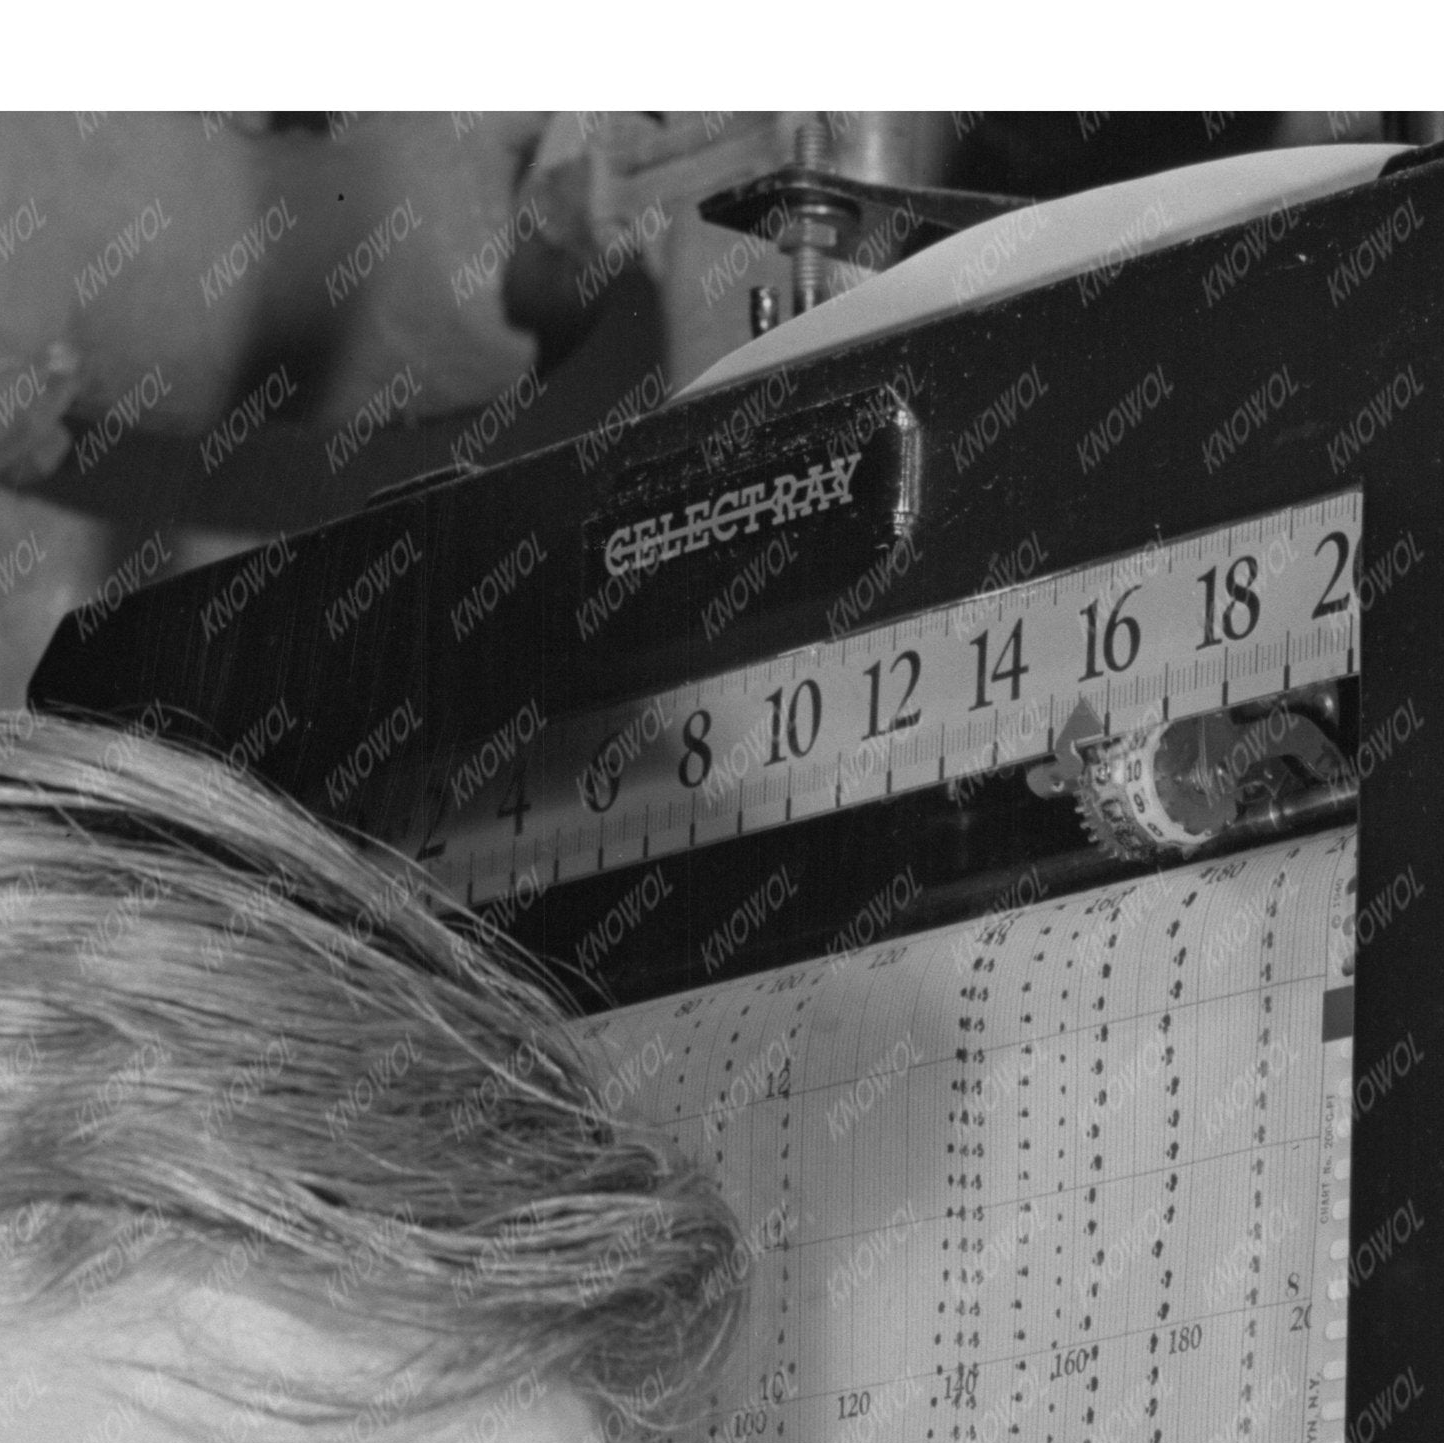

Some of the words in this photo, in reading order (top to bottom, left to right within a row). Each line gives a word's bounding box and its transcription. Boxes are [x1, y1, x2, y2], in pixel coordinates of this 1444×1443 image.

[605, 452, 861, 576] CELECTRAY
[1195, 555, 1262, 651] 18
[1311, 530, 1361, 621] 2
[968, 617, 1030, 712] 14
[1077, 583, 1144, 683] 16
[763, 678, 823, 768] 10
[860, 649, 923, 742] 12
[586, 732, 621, 813] 6
[677, 709, 713, 789] 8
[1126, 758, 1143, 784] 10
[497, 757, 532, 836] 4
[867, 946, 909, 970] 120
[1319, 1182, 1331, 1225] CHART
[1286, 1272, 1300, 1297] 8
[1053, 1348, 1088, 1378] 160
[1168, 1324, 1203, 1354] 180
[733, 1410, 767, 1438] 100
[760, 1371, 784, 1402] 10
[837, 1391, 872, 1420] 120
